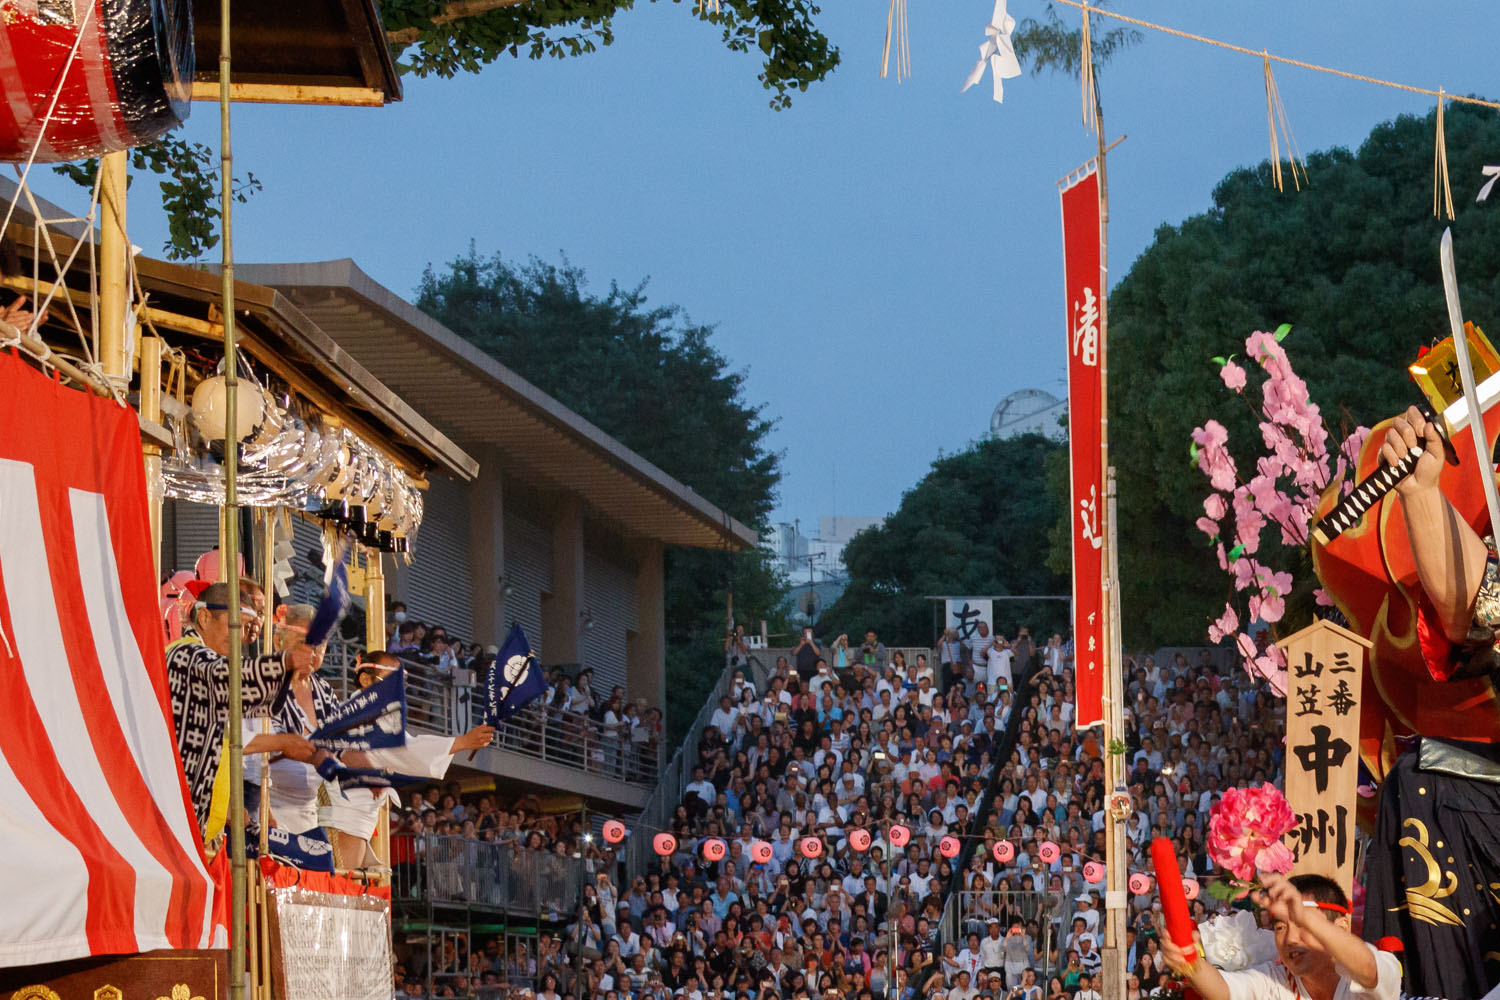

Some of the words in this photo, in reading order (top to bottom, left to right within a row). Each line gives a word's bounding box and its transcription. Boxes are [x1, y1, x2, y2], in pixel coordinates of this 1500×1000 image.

[1293, 651, 1325, 718] 山笠
[1327, 651, 1358, 717] 三番
[1286, 724, 1353, 869] 中洲
